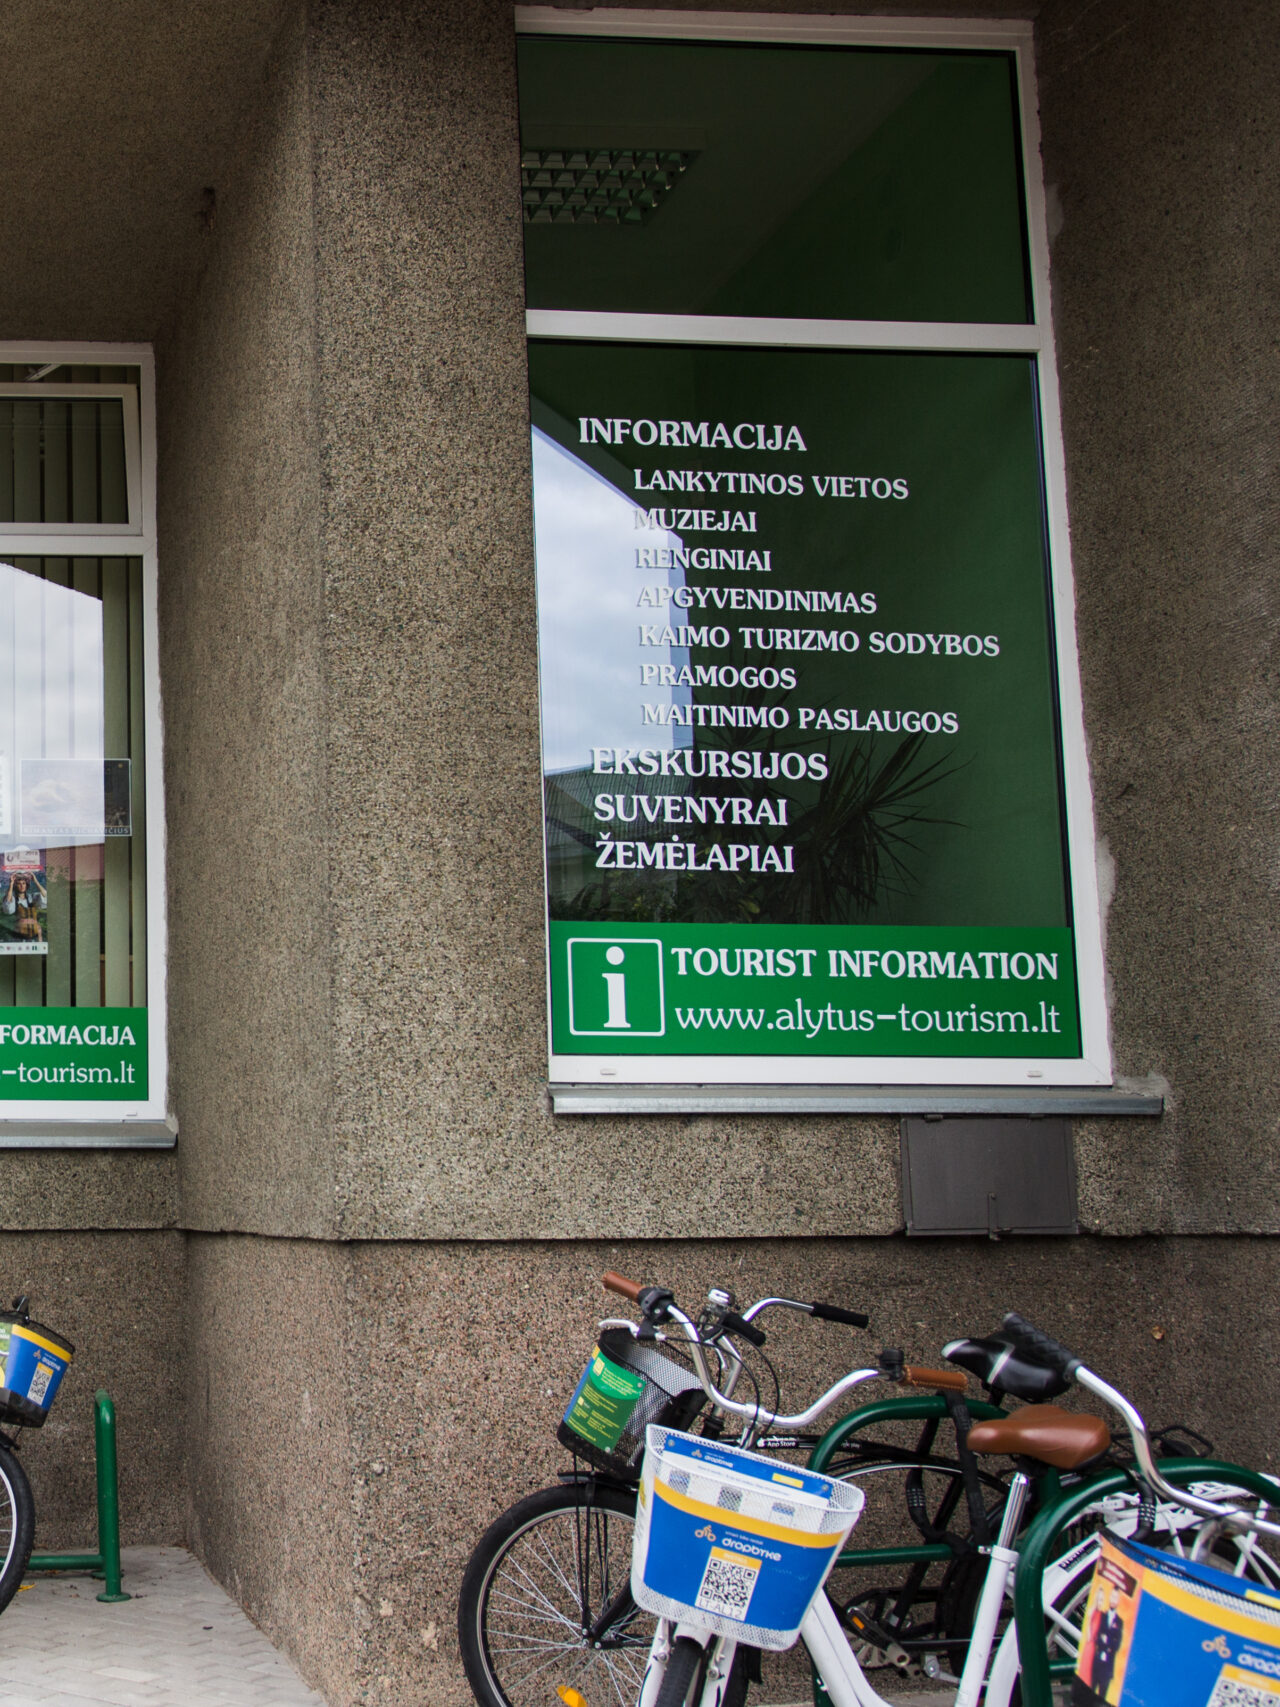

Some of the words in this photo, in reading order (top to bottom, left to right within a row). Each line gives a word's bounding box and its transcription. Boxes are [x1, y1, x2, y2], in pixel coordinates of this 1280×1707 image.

[578, 417, 807, 452] INFORMACIJA
[633, 469, 804, 496] LANKYTINOS
[812, 475, 909, 500] VIETOS
[633, 508, 758, 533] MUZIEJAI
[634, 547, 772, 572] RENGINIAI
[636, 586, 877, 614] APGYVENDINIMAS
[638, 624, 731, 650] KAIMO
[739, 627, 861, 653] TURIZMO
[868, 631, 1000, 657] SODYBOS
[640, 664, 797, 690] PRAMOGOS
[641, 703, 789, 730] MAITINIMO
[798, 708, 959, 734] PASLAUGOS
[591, 747, 829, 781] EKSKURSIJOS
[594, 793, 789, 826] SUVENYRAI
[594, 832, 795, 874] ŽEMĖLAPIAI
[671, 947, 816, 978] TOURIST
[828, 949, 1059, 981] INFORMATION
[674, 998, 1061, 1039] www.alytus-tourism.lt
[1237, 1653, 1280, 1676] drop
